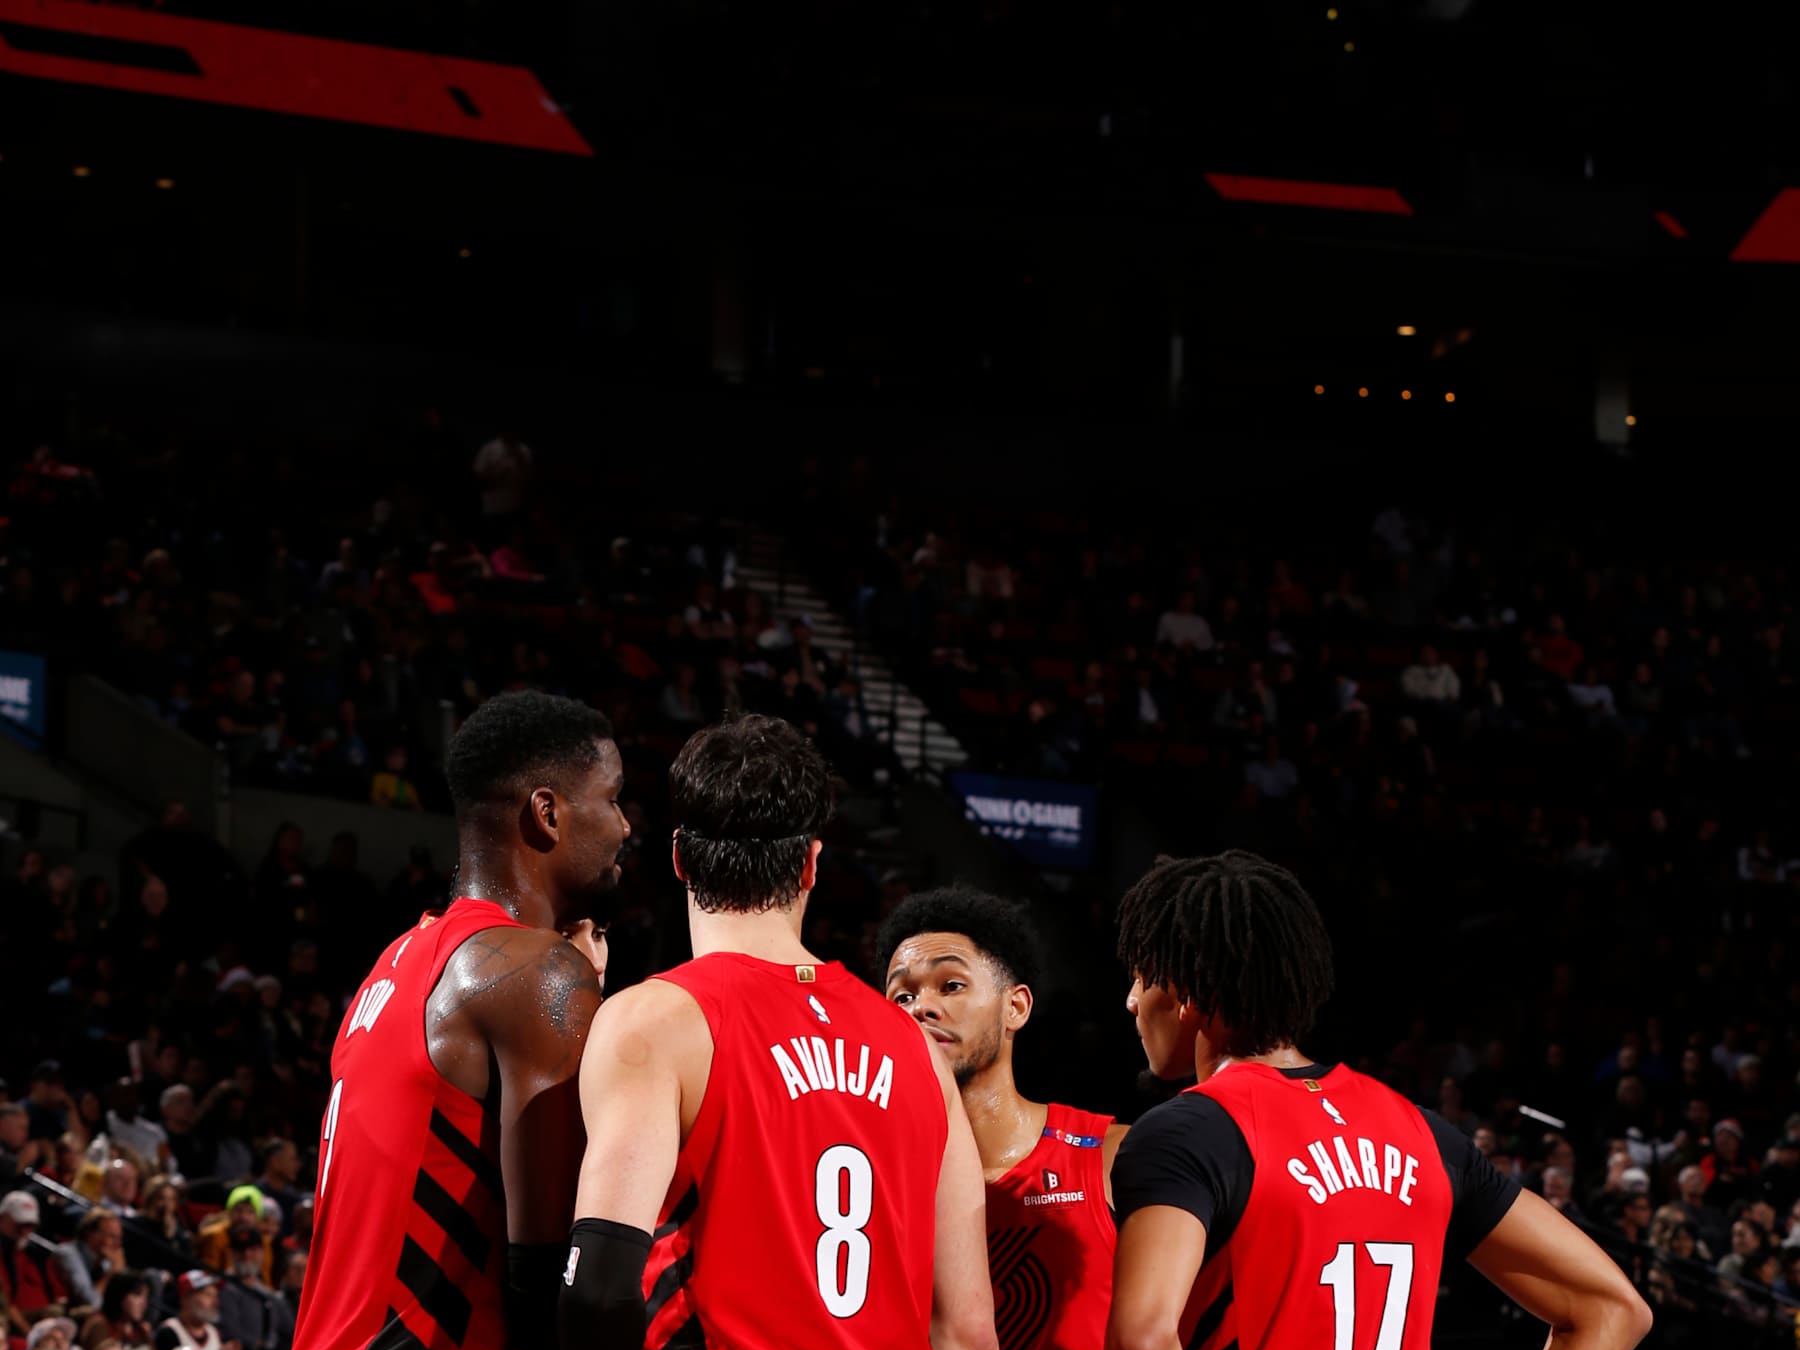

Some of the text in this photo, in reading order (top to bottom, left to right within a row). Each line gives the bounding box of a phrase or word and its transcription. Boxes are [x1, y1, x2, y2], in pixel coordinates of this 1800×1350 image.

[769, 1035, 894, 1110] AVDIJA
[1023, 1191, 1085, 1206] BRIGHTSIDE
[1287, 1136, 1419, 1206] SHARPE
[815, 1144, 873, 1319] 8
